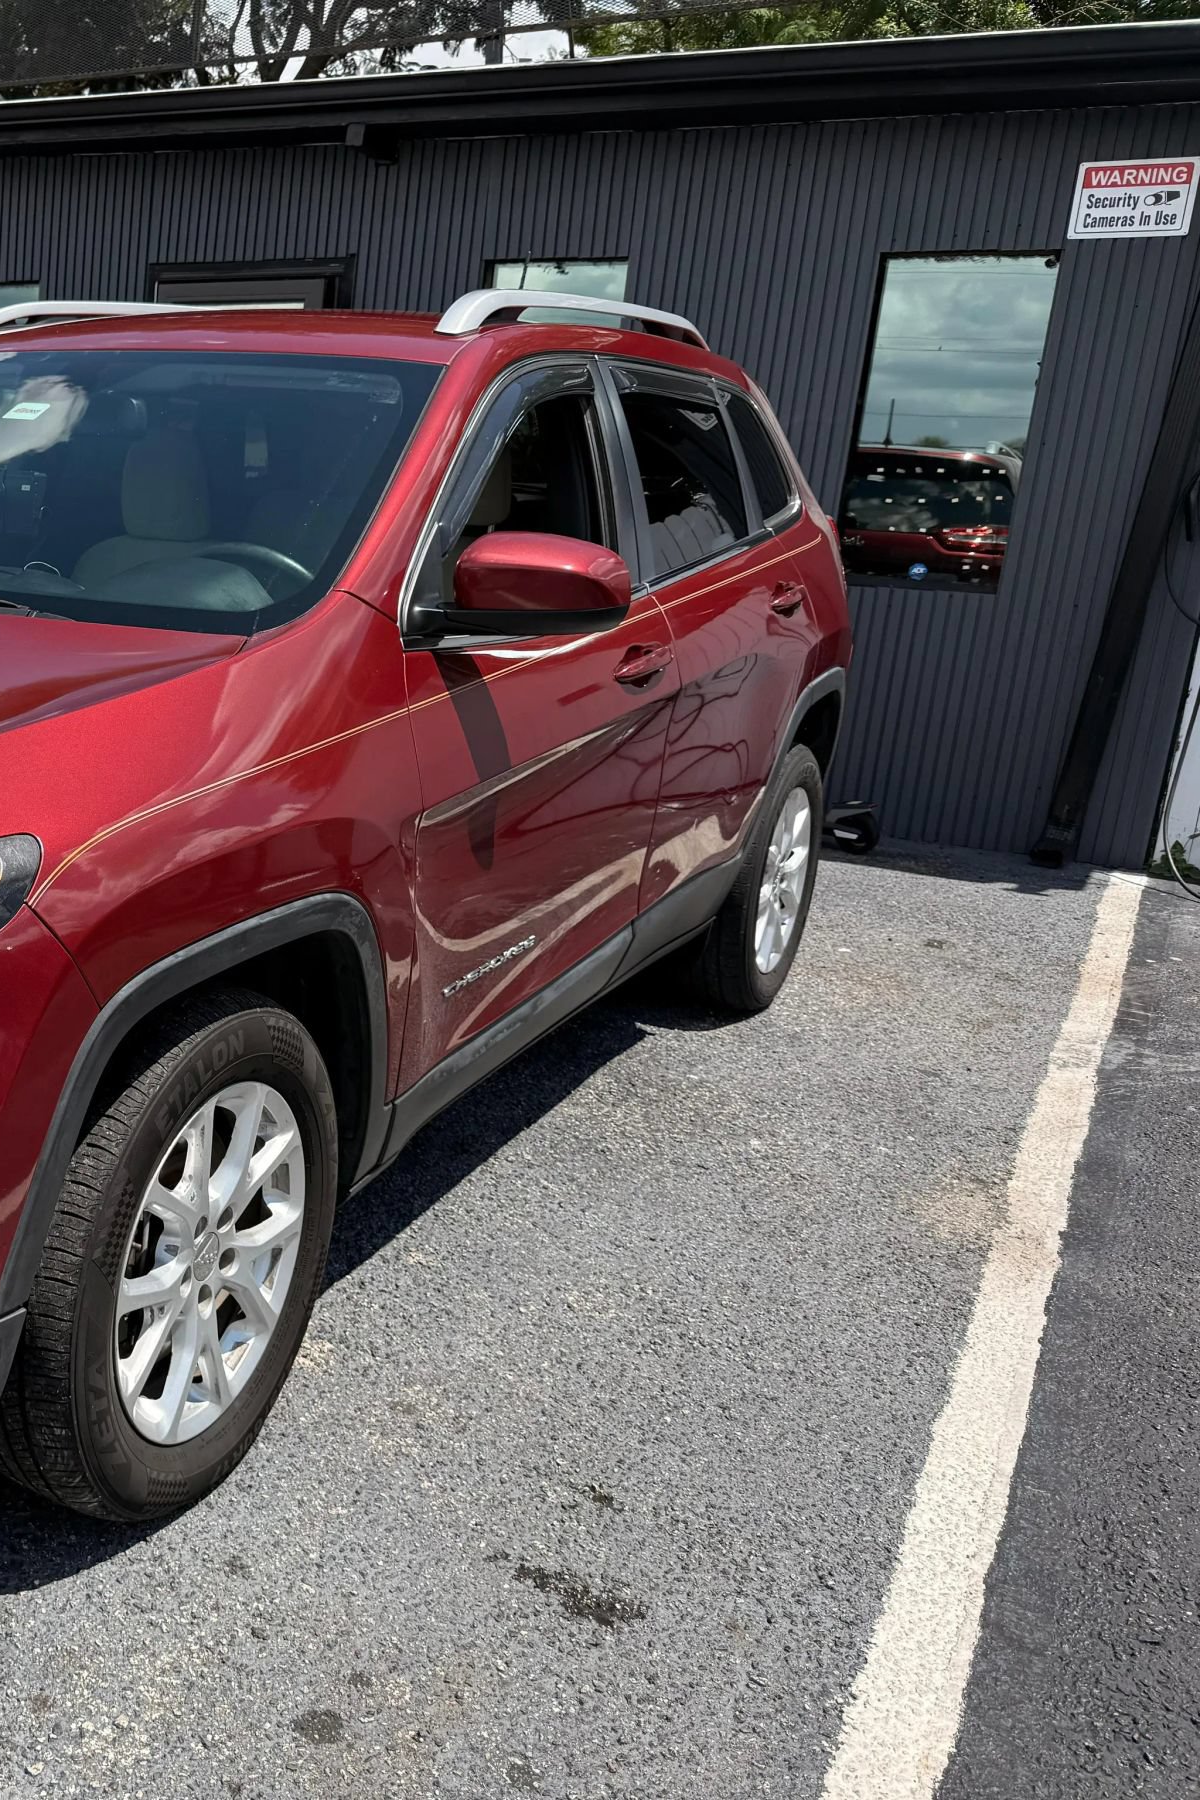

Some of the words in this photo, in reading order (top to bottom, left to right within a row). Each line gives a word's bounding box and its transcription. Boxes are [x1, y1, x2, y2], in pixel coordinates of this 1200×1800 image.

[1091, 166, 1188, 186] WARNING
[1086, 192, 1140, 211] Security
[1083, 213, 1135, 229] Cameras
[1139, 211, 1151, 226] In
[1155, 210, 1177, 226] Use
[442, 934, 536, 998] CHEROKEE
[154, 1029, 244, 1140] ETALON
